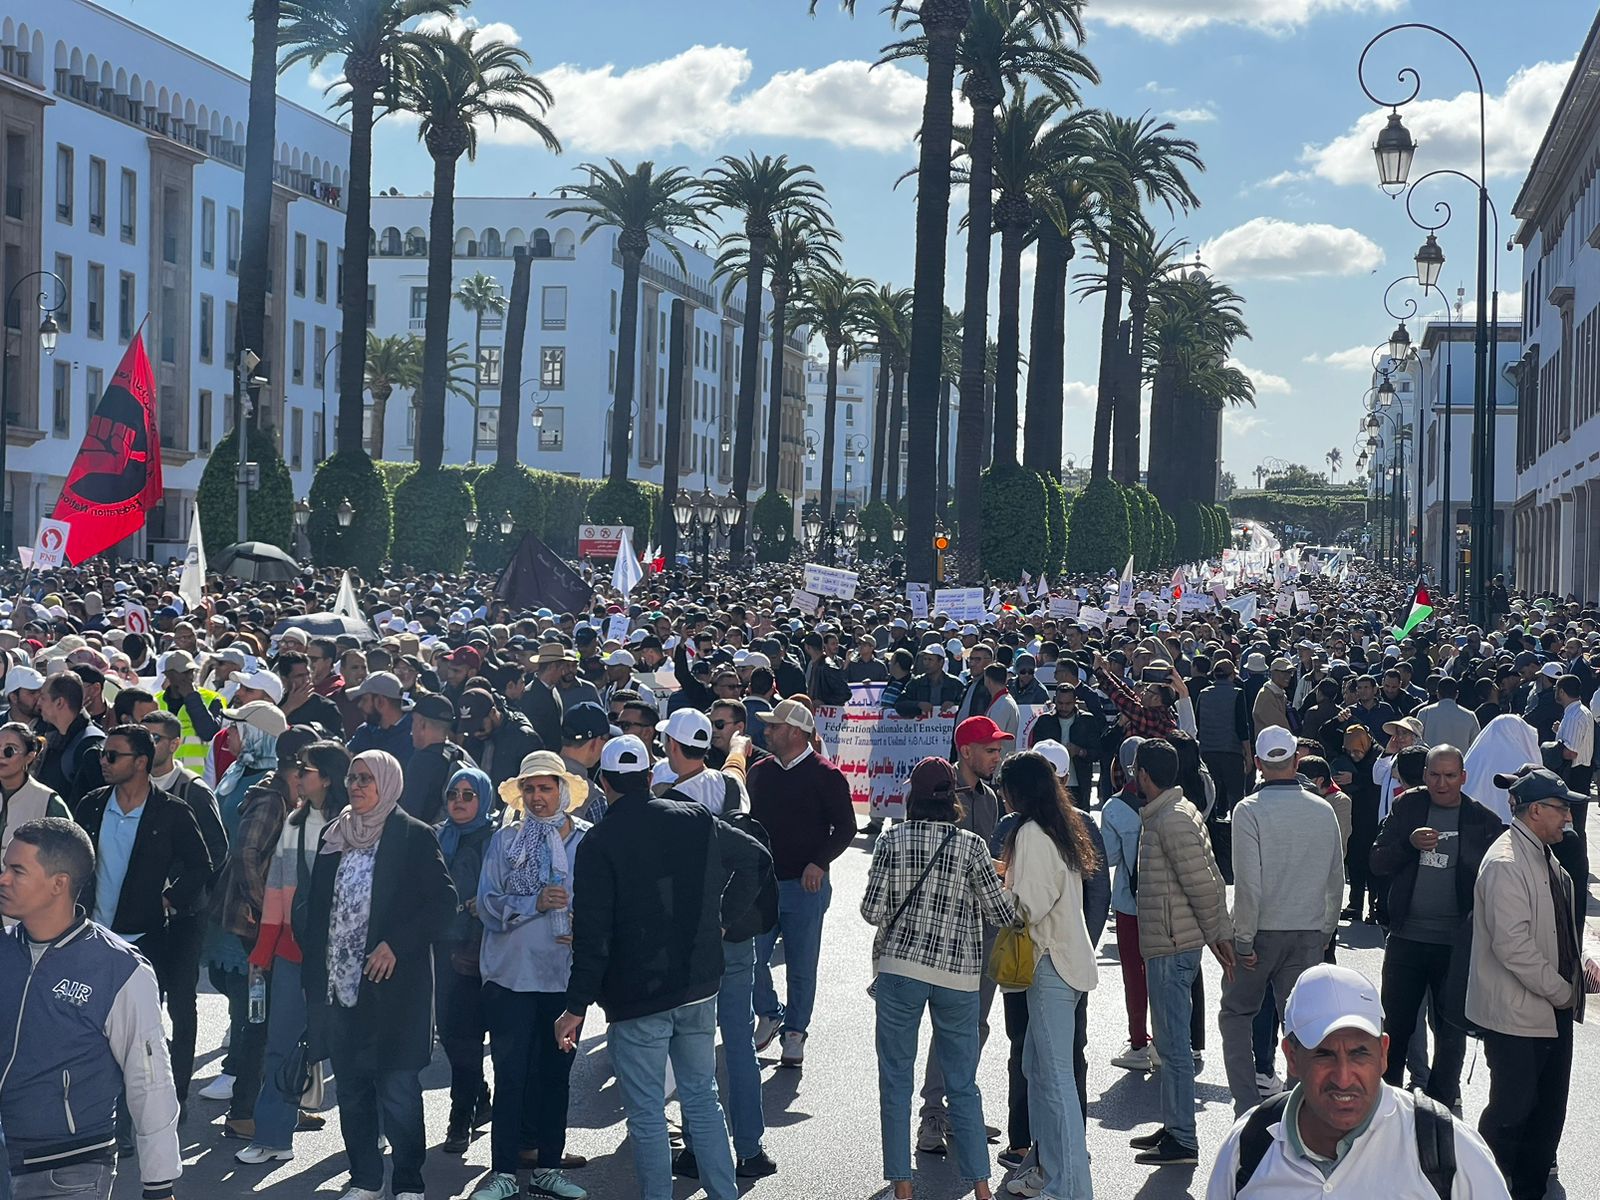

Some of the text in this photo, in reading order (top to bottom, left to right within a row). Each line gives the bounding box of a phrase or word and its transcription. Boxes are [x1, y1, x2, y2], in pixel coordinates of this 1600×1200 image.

[40, 552, 57, 563] FNE
[824, 722, 952, 735] Fédération Nationale de l'Enseign
[52, 978, 93, 1003] AIR
